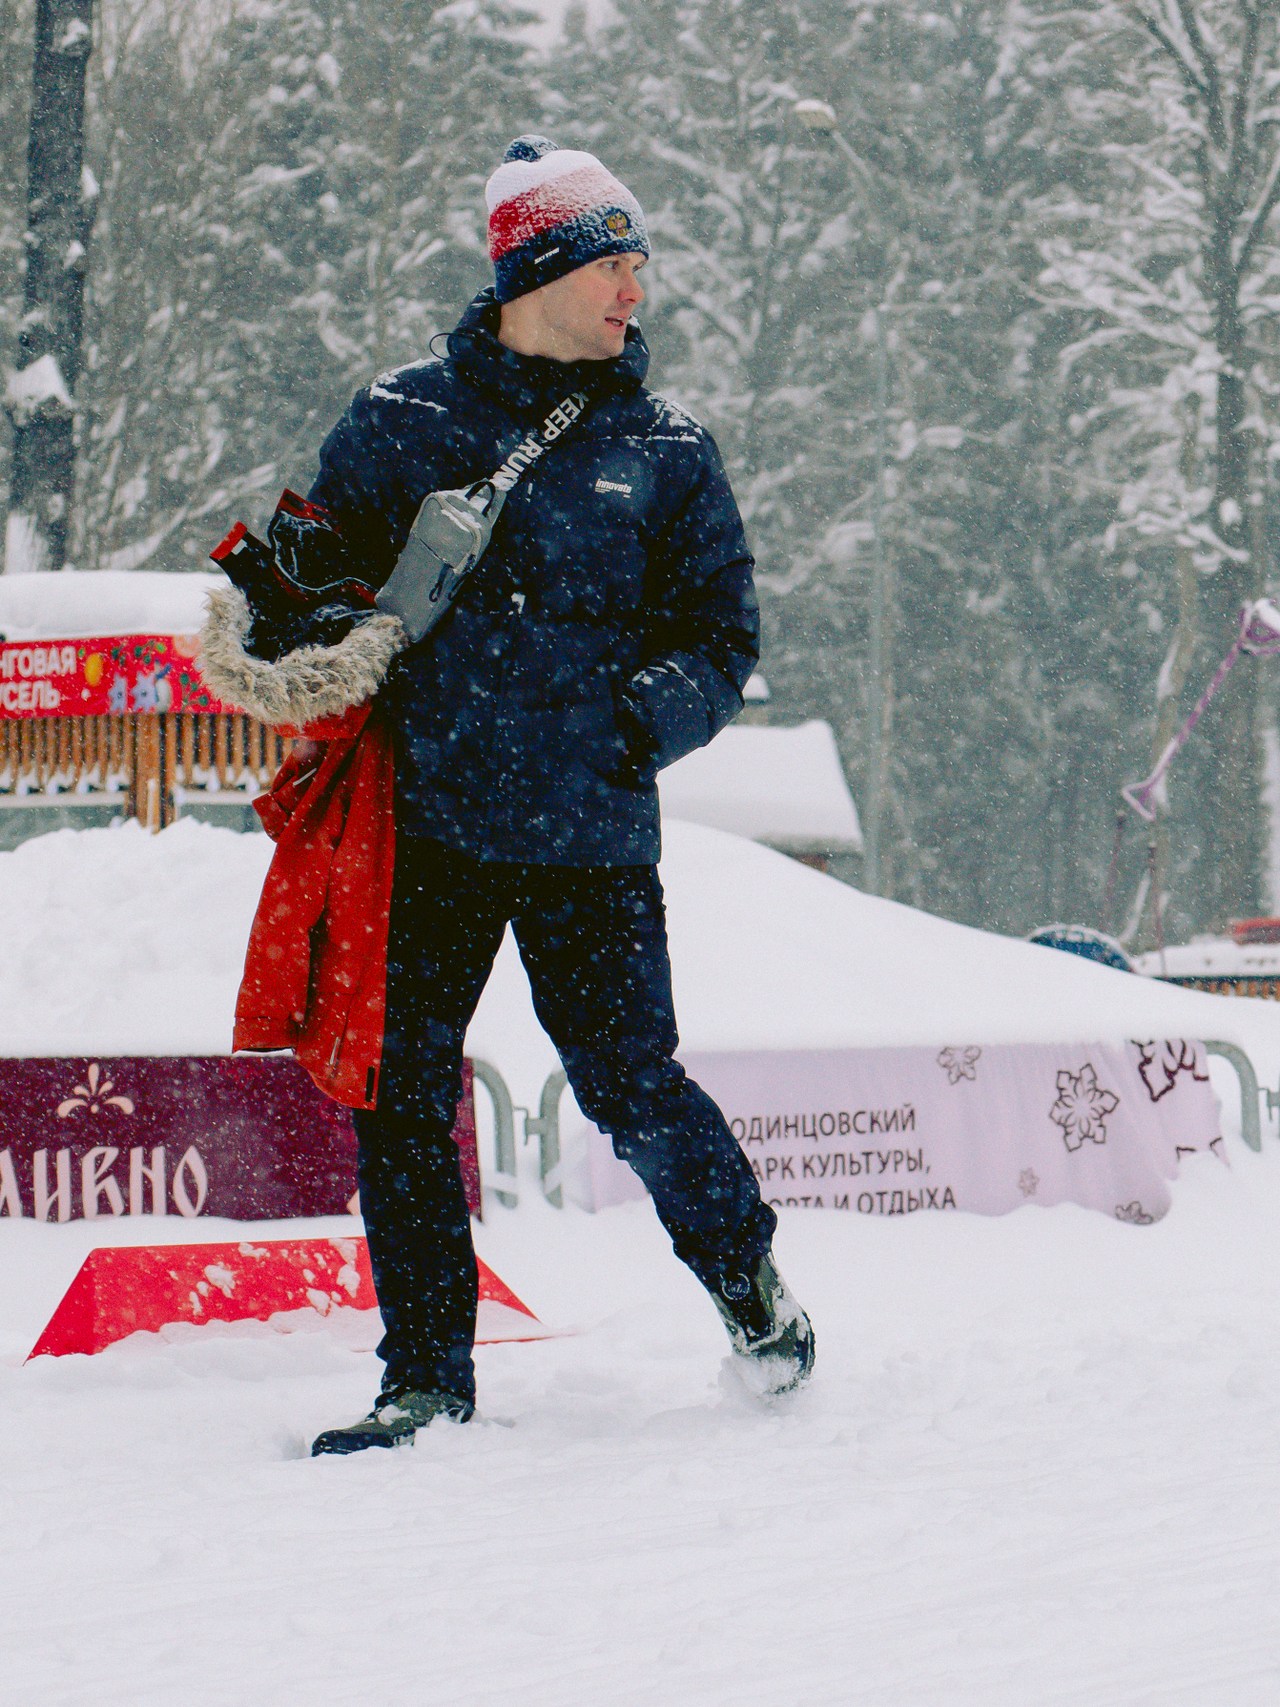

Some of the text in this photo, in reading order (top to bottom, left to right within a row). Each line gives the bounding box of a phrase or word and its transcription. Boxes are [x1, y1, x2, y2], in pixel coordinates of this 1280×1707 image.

[544, 392, 589, 440] KEEP
[731, 1103, 916, 1145] ОДИНЦОВСКИЙ
[752, 1148, 931, 1182] АРК КУЛЬТУРЫ,
[857, 1187, 957, 1215] ОТДЫХА
